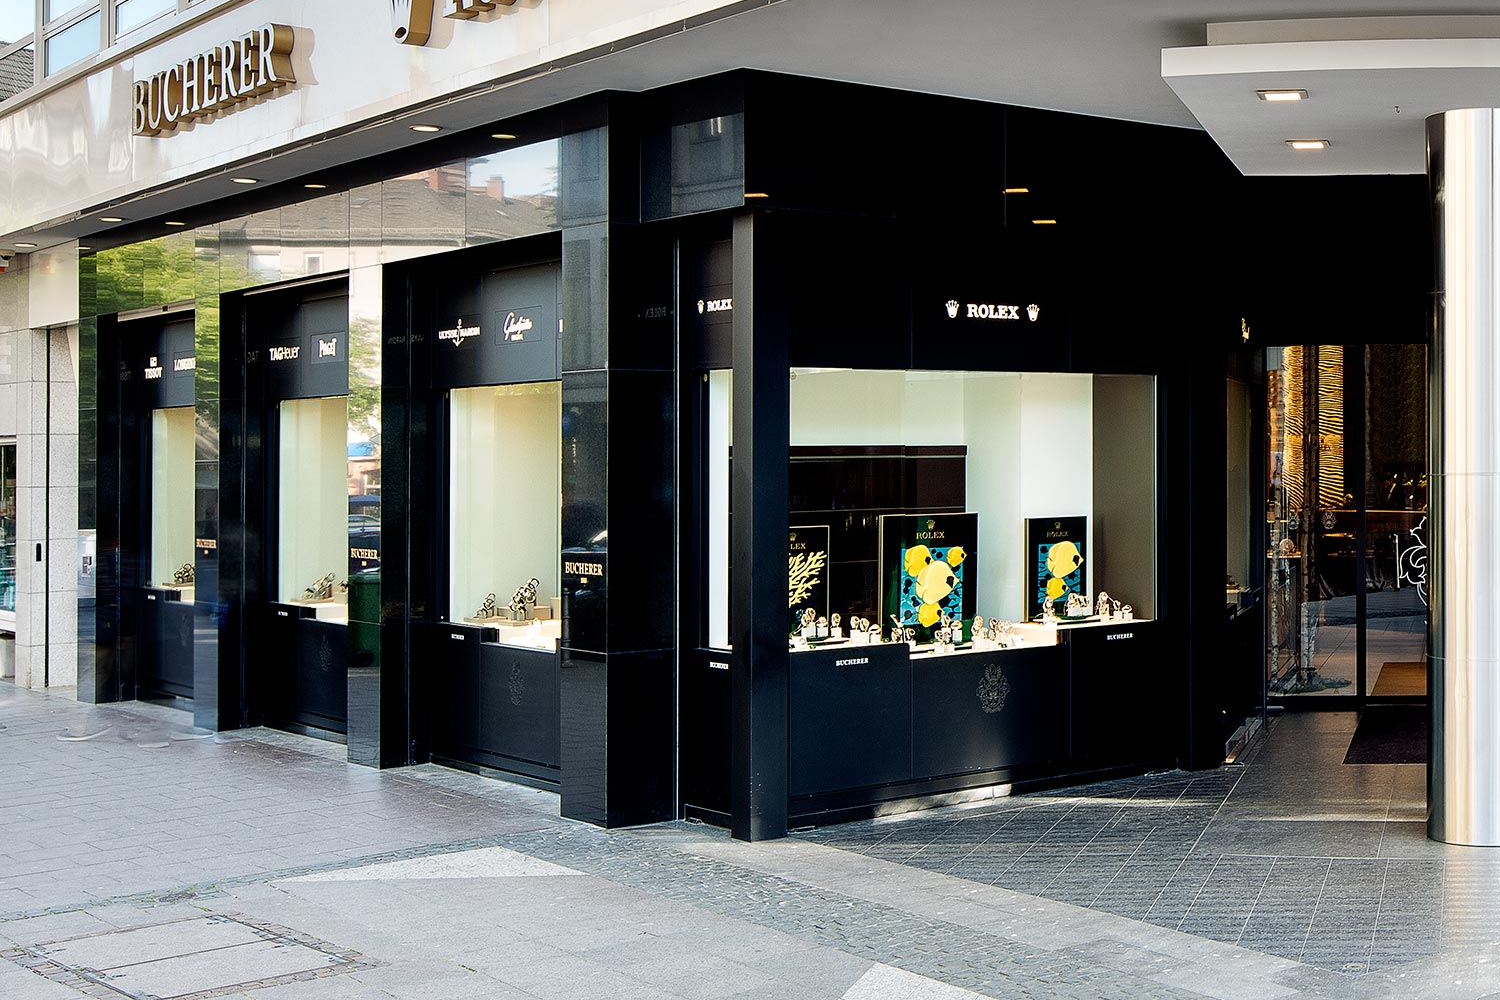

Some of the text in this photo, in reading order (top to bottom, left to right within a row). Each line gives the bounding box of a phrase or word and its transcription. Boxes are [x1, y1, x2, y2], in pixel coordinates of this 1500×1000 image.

[132, 22, 295, 137] BUCHERER
[707, 298, 732, 312] ROLEX
[967, 303, 1020, 320] ROLEX
[916, 531, 945, 539] ROLEX
[790, 542, 806, 550] LEX
[564, 561, 604, 577] BUCHERER
[836, 656, 870, 667] BUCHERER
